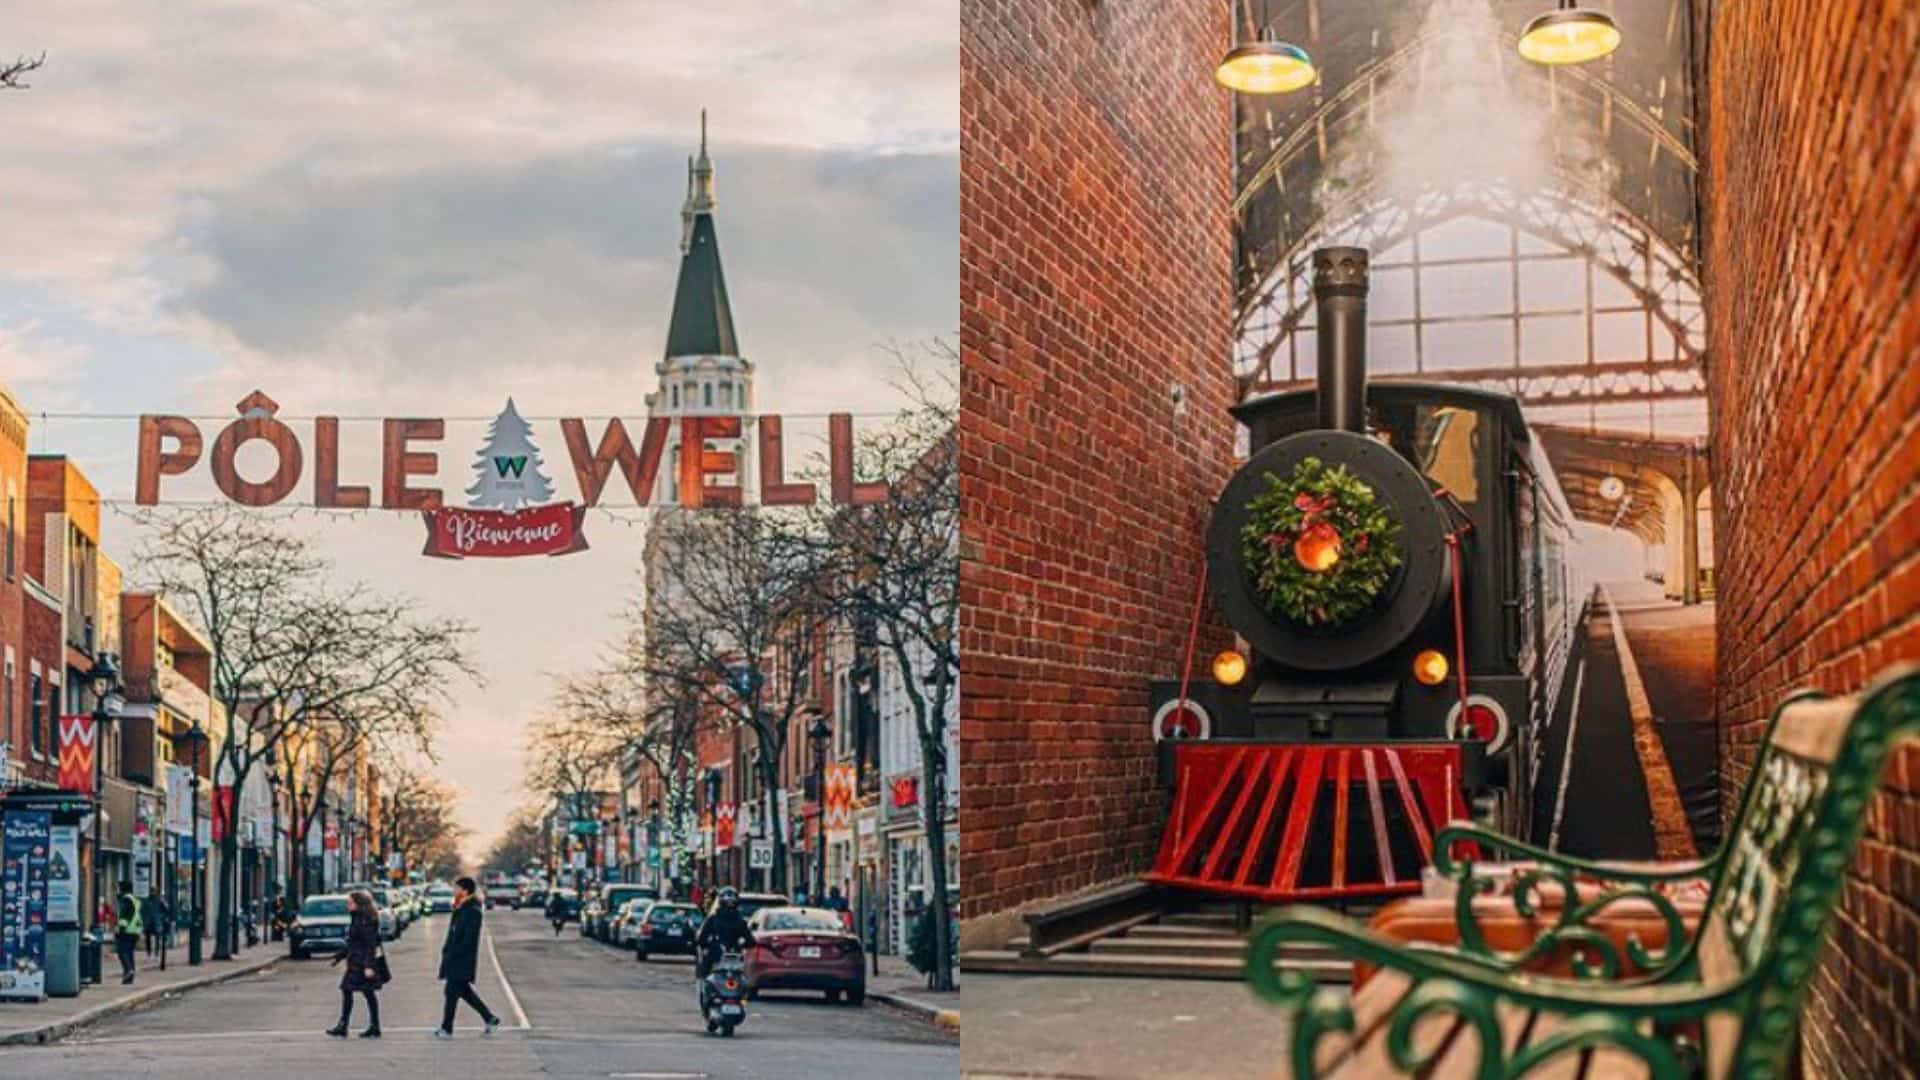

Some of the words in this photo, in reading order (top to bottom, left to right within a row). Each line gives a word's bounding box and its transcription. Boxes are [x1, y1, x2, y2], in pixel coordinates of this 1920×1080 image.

[135, 389, 445, 509] PÔLE
[560, 412, 889, 508] WELL
[494, 455, 528, 478] W
[446, 514, 562, 551] Bienvenue
[753, 847, 771, 864] 30
